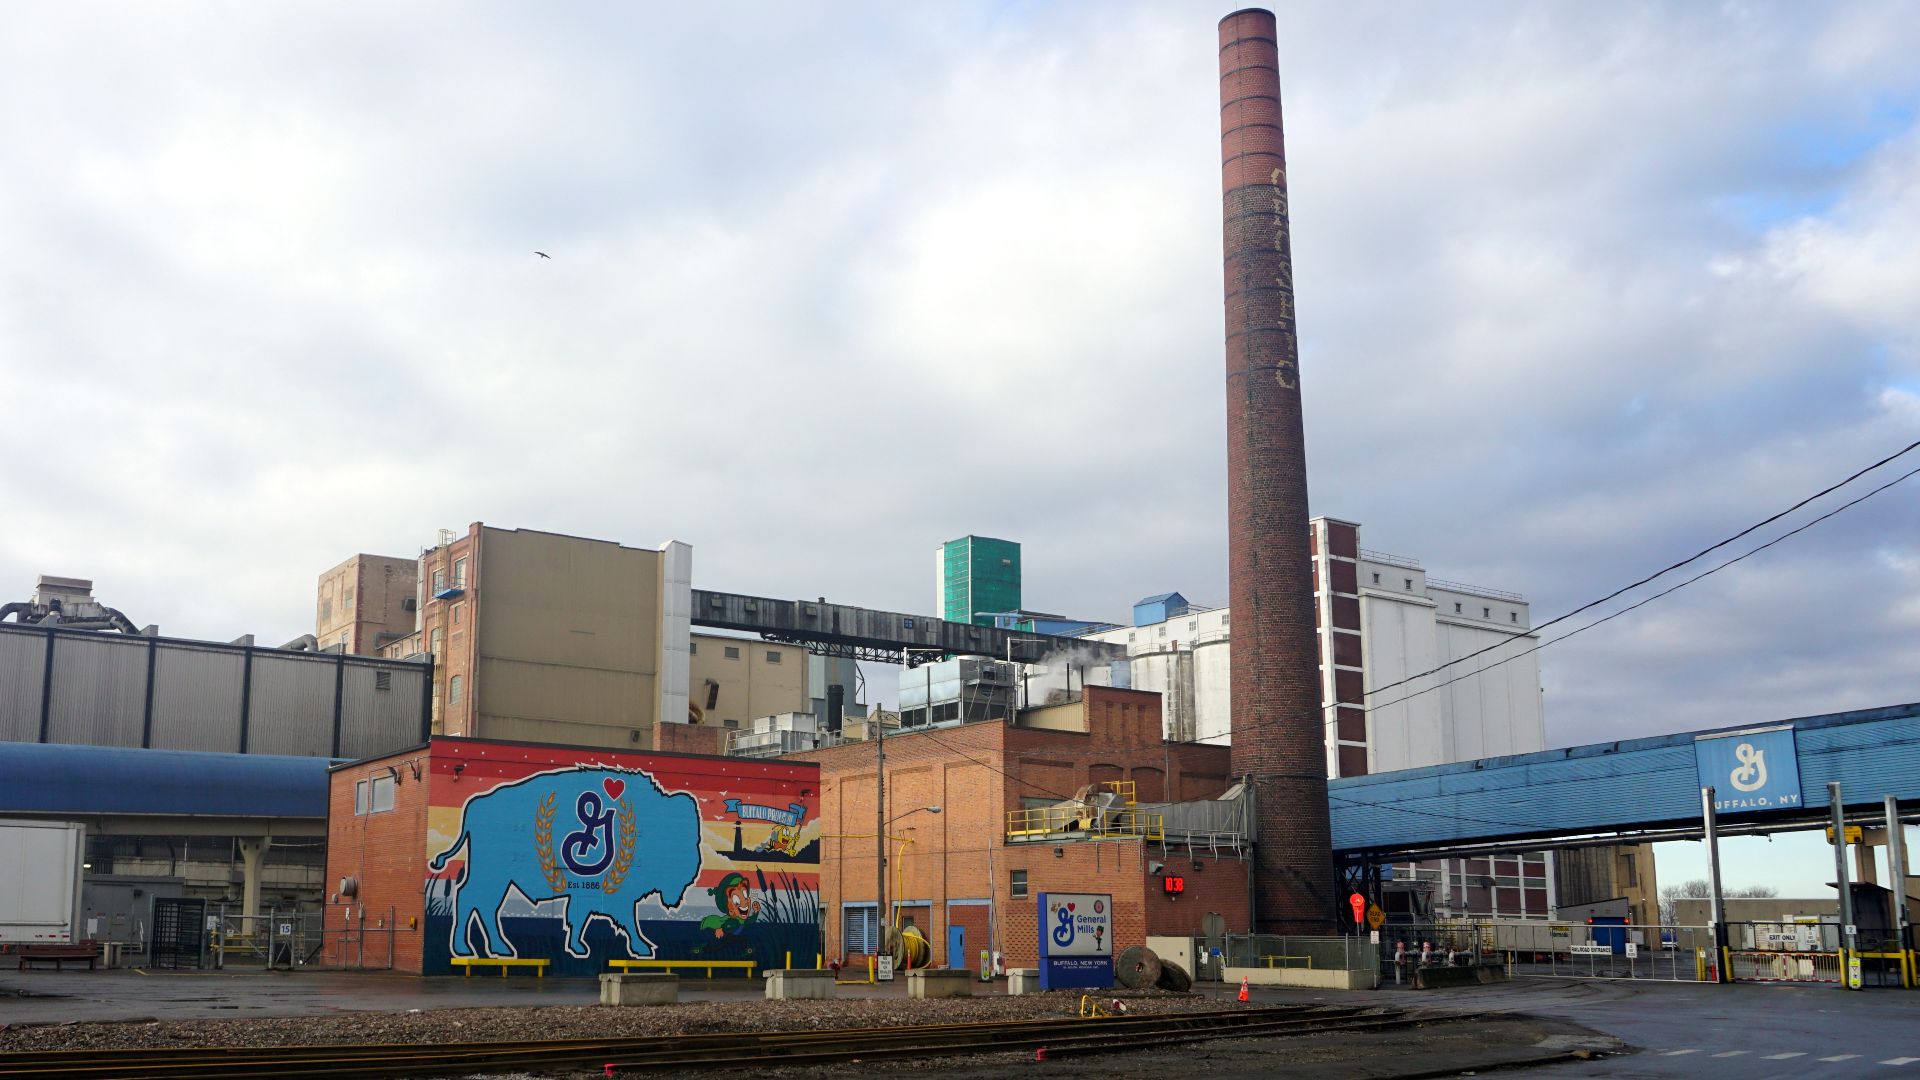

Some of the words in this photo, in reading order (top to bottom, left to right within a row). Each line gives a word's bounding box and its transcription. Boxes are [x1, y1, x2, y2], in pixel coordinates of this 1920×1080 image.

[1714, 798, 1772, 810] UFFALO,
[1779, 794, 1798, 804] NY
[1076, 914, 1107, 924] General
[1076, 925, 1095, 934] Mills
